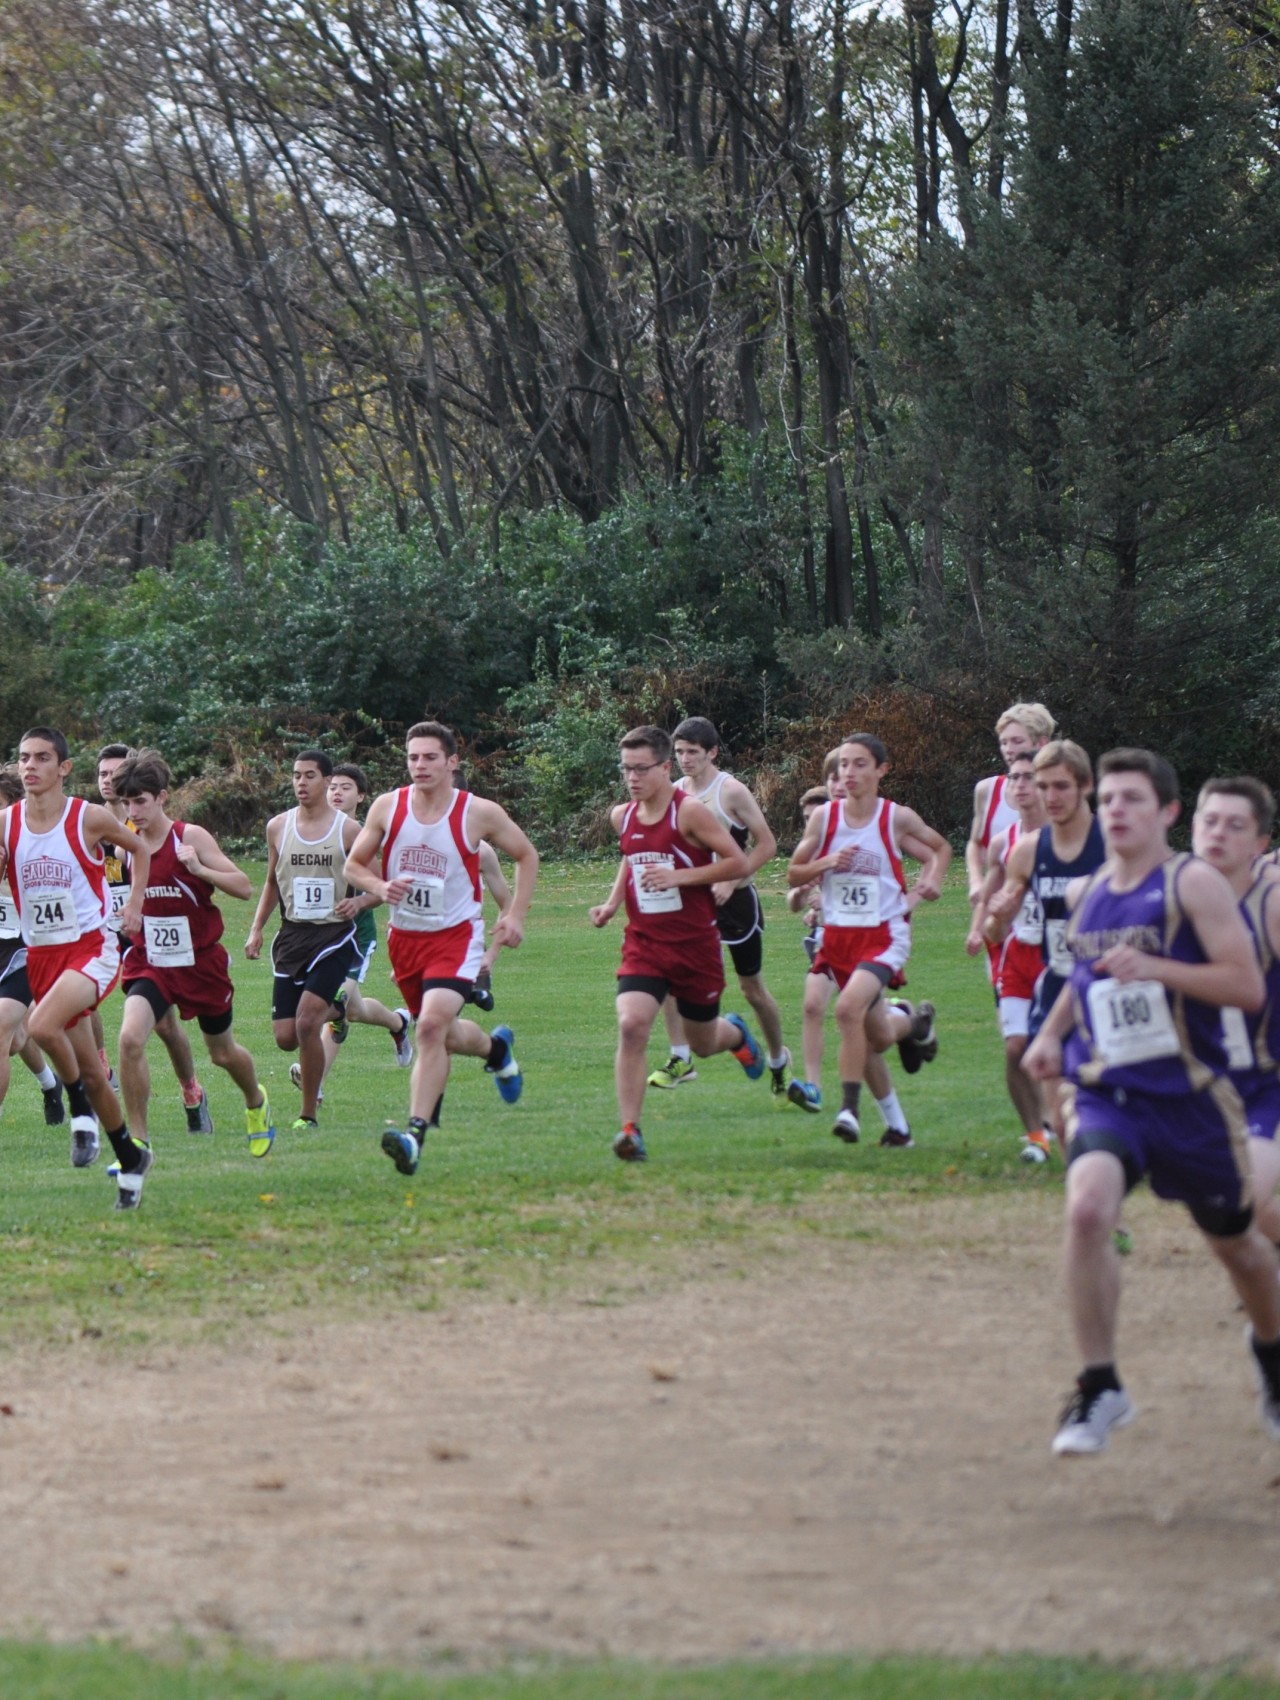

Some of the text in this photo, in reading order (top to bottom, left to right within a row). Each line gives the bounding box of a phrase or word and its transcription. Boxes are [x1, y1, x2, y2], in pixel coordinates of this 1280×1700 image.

[291, 854, 332, 866] BECAHI
[400, 850, 447, 872] SAUCON
[22, 862, 72, 882] SAUCON
[43, 880, 72, 889] COUNTRY
[305, 887, 321, 903] 19
[842, 887, 867, 906] 245
[34, 902, 64, 925] 244
[153, 928, 180, 947] 229
[1109, 993, 1150, 1028] 180
